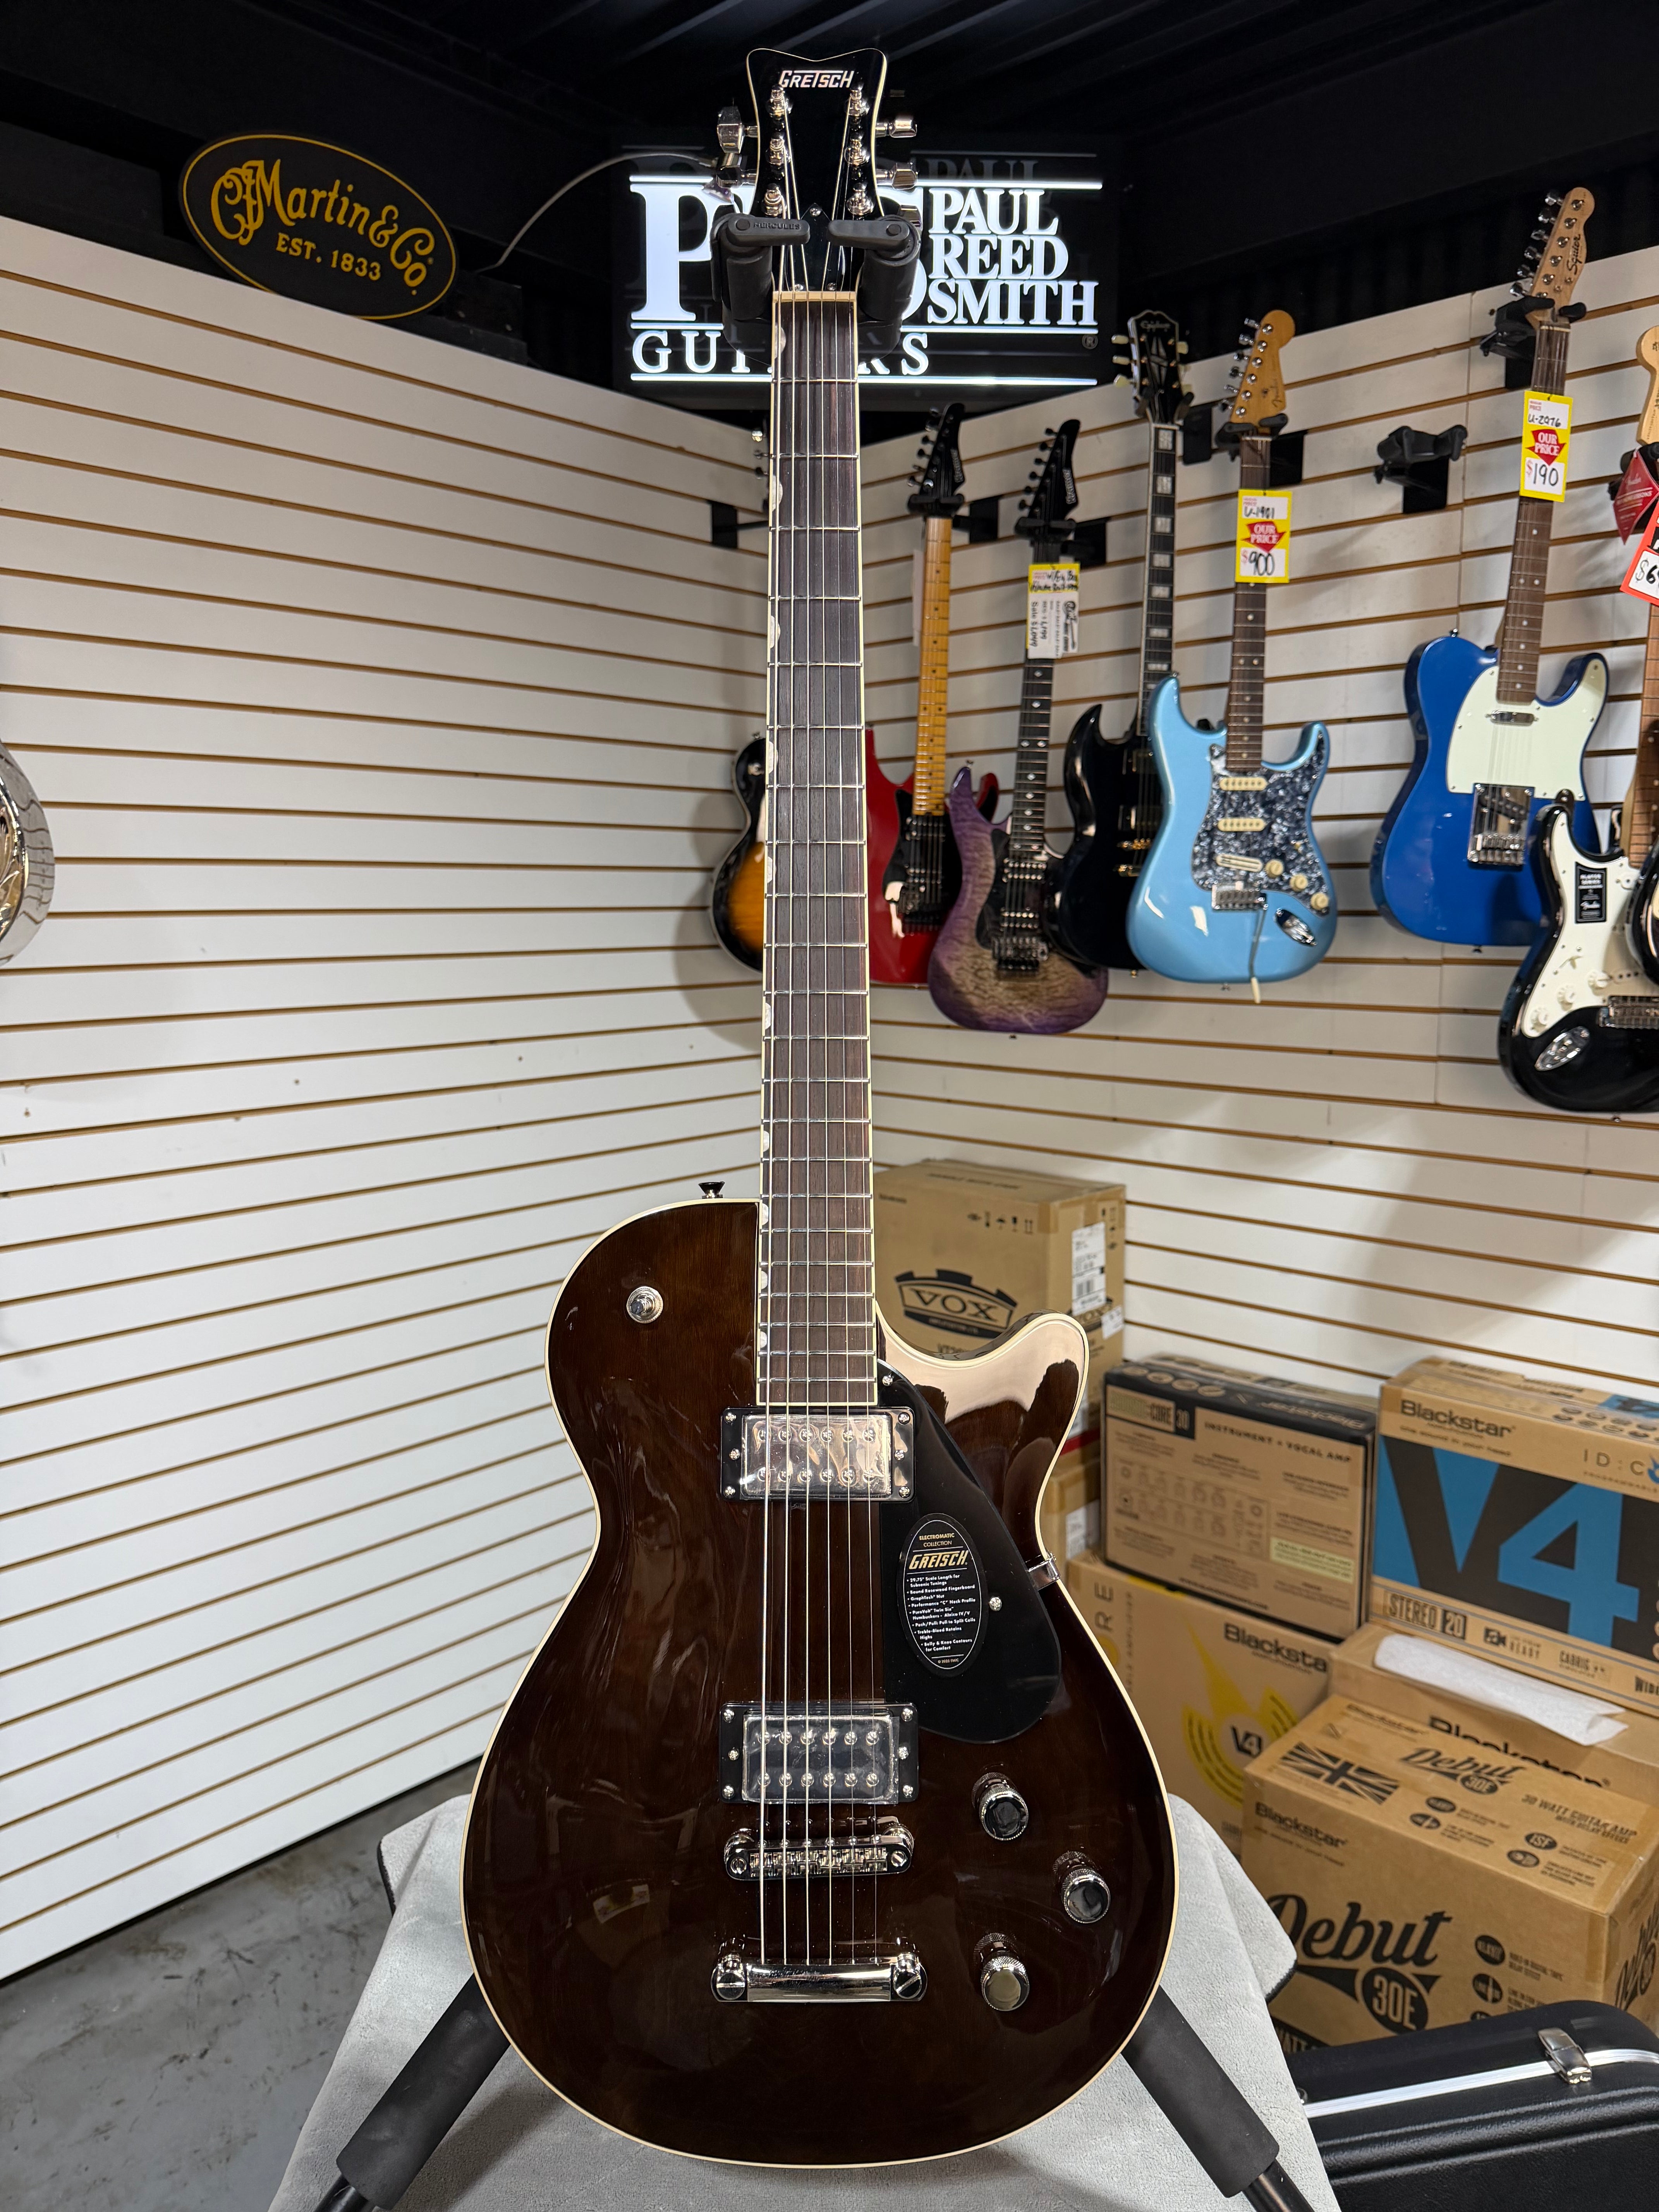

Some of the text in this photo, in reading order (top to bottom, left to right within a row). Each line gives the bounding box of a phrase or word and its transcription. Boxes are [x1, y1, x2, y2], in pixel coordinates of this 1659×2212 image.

[779, 70, 854, 88] GRETSCH
[929, 188, 1059, 235] PAUL
[276, 233, 381, 281] EST. 1833
[929, 234, 1068, 280] REED
[1566, 234, 1581, 275] Squier
[927, 278, 1099, 325] SMITH
[1534, 443, 1560, 456] PRICE
[1538, 432, 1558, 444] OUR
[1251, 534, 1279, 544] PRICE
[1254, 523, 1276, 534] OUR
[1635, 558, 1659, 584] $6
[910, 1288, 998, 1322] VOX
[1401, 1399, 1511, 1437] Blackstar
[1204, 1421, 1273, 1444] INSTRUMENT
[1286, 1441, 1322, 1458] VOCAL
[1326, 1451, 1351, 1463] AMP
[909, 1550, 968, 1569] GRETSCH
[1390, 1593, 1465, 1638] STEREO 20
[1224, 1622, 1328, 1672] Blacksta
[1400, 1747, 1527, 1778] Debut
[1255, 1801, 1347, 1848] Blackstar
[1539, 1799, 1570, 1815] WATT
[1266, 1894, 1453, 1966] Debut
[1372, 1974, 1419, 2031] 30E
